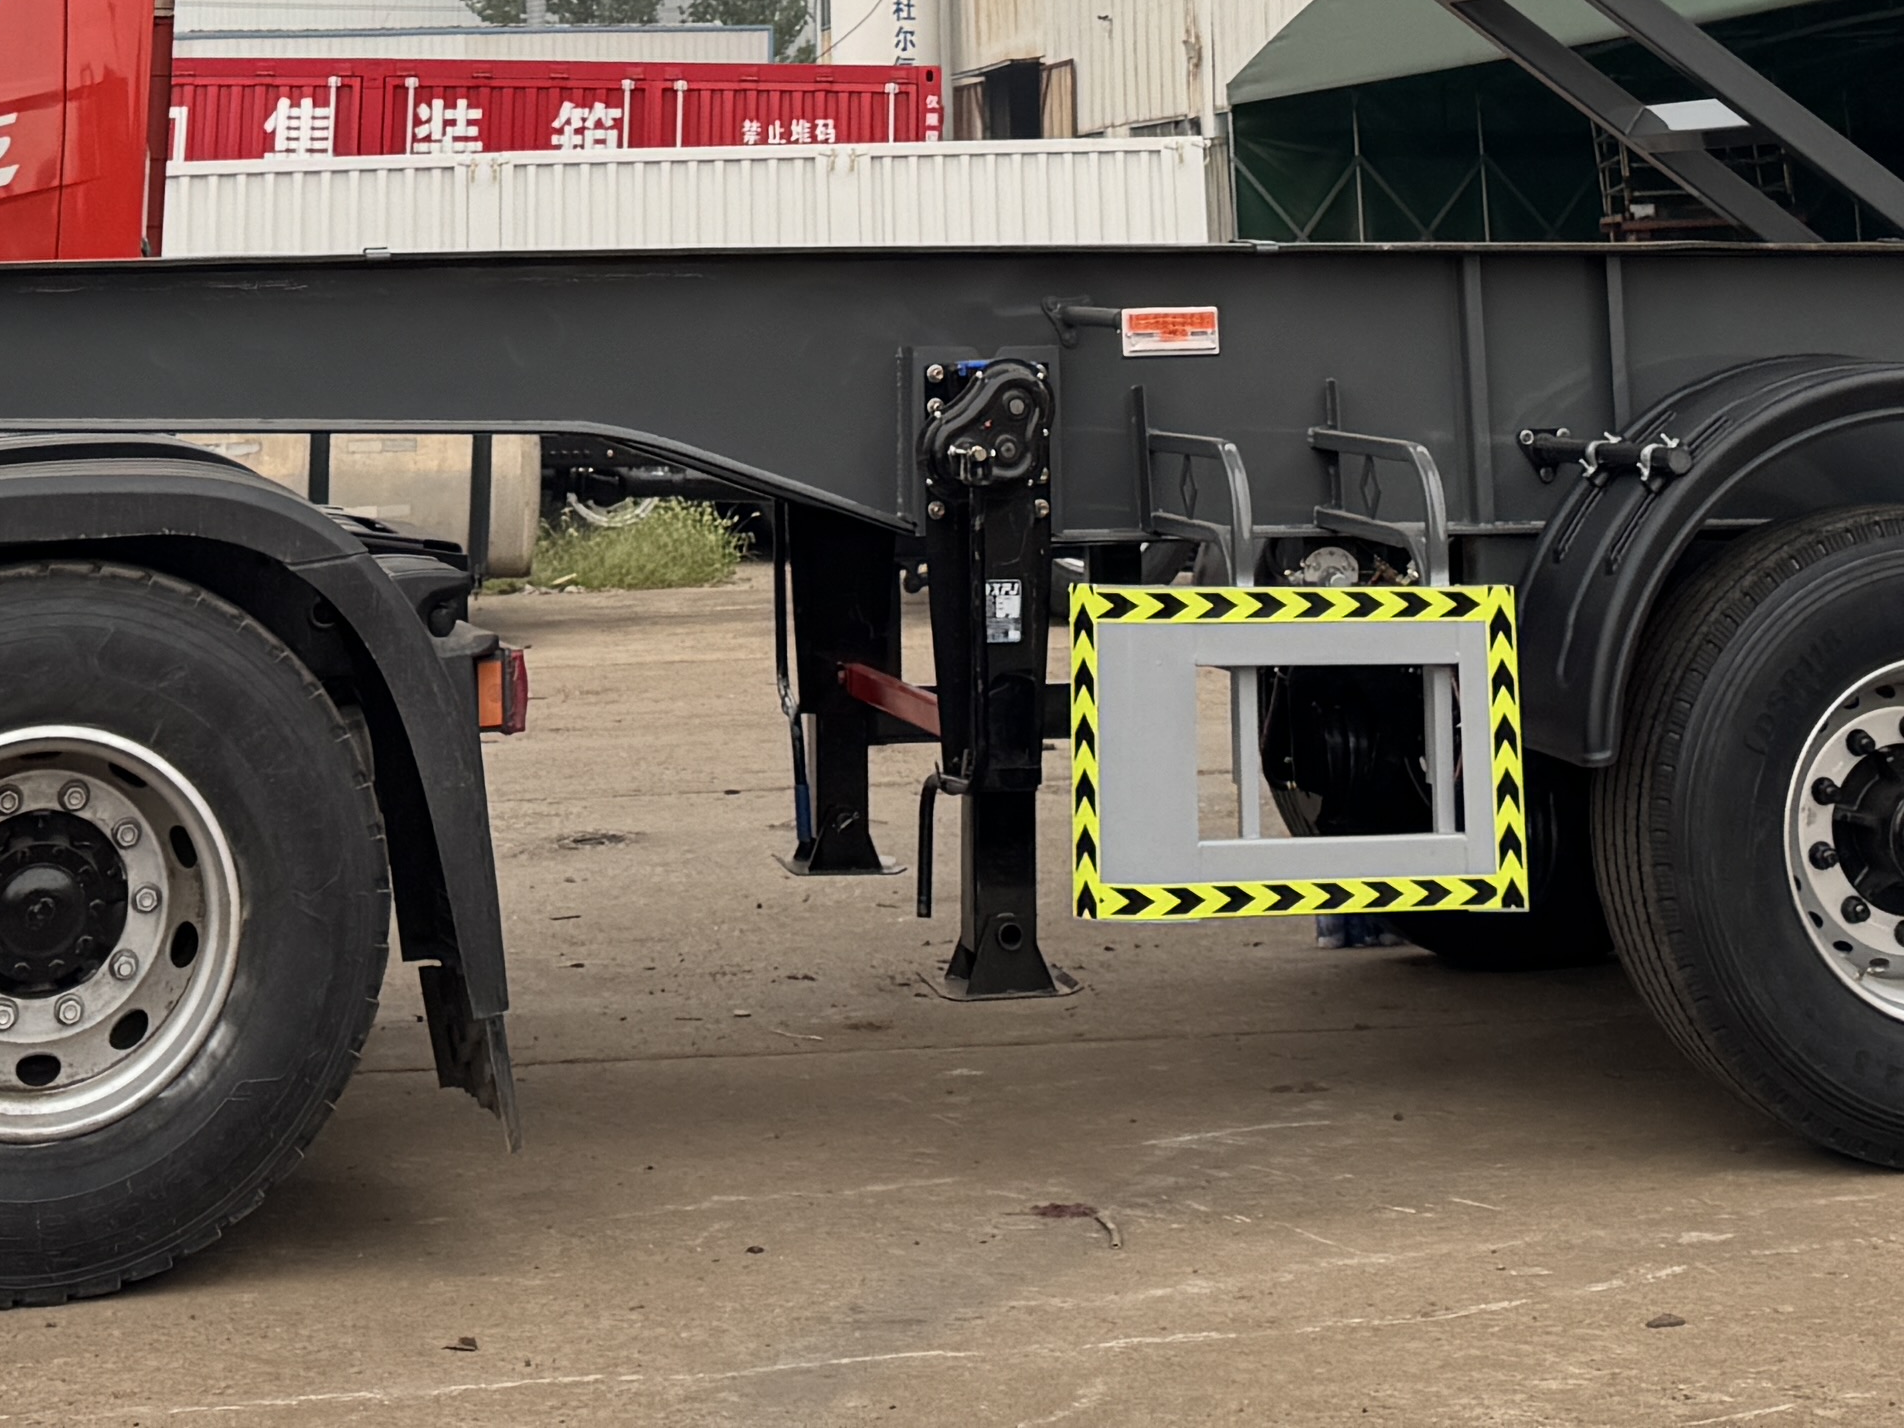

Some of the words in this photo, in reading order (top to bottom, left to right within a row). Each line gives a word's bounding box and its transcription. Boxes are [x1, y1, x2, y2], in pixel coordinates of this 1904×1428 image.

[169, 96, 623, 162] 集装箱
[741, 118, 836, 145] 禁止堆码
